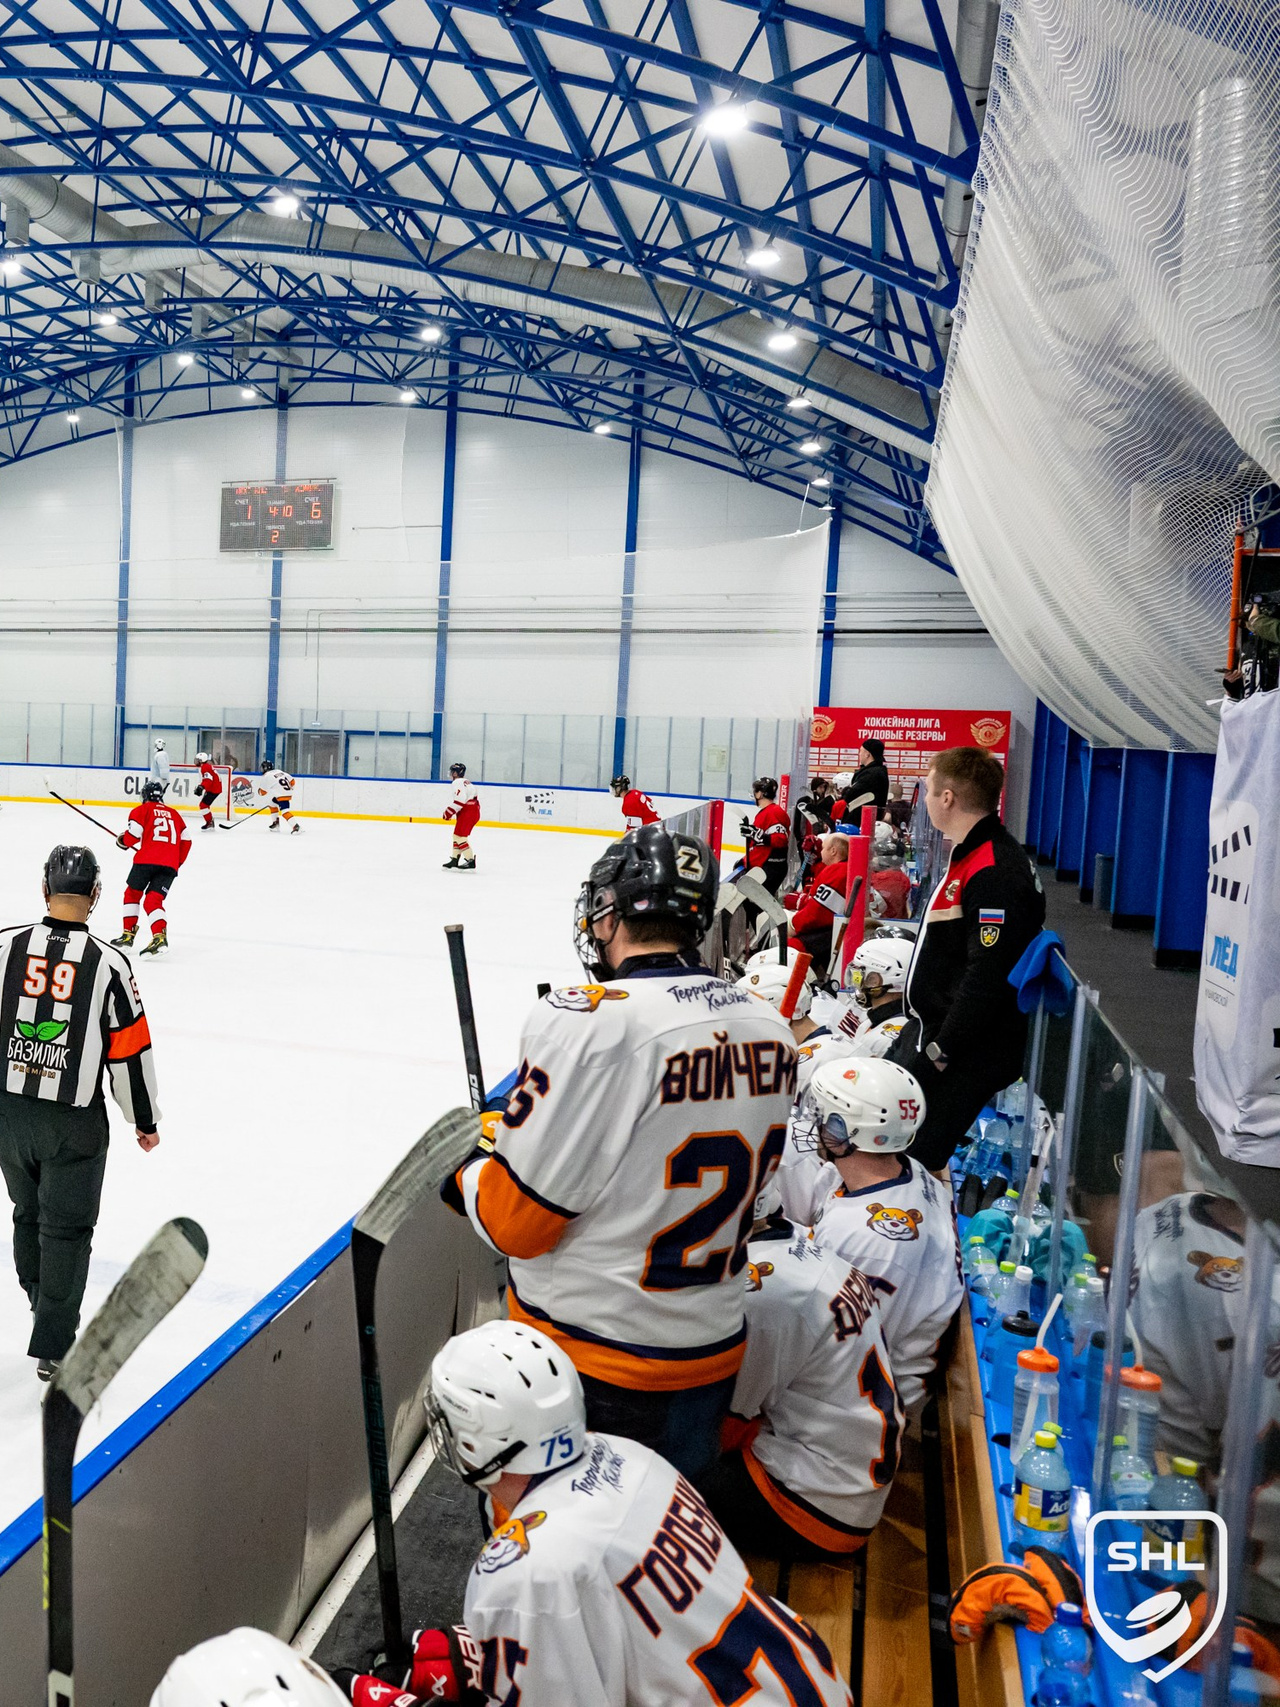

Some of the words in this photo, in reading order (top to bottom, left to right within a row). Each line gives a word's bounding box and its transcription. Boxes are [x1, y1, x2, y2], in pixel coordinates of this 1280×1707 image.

[247, 505, 252, 520] 1
[269, 505, 293, 517] 4:10
[311, 502, 321, 519] 6
[271, 530, 280, 543] 2
[864, 716, 916, 728] ХОККЕЙНАЯ
[916, 718, 941, 729] ЛИГА
[857, 729, 904, 740] ТРУДОВЫЕ
[905, 730, 946, 741] РЕЗЕРВЫ
[172, 777, 190, 798] 41
[152, 817, 178, 845] 21
[817, 883, 831, 901] 20
[46, 934, 70, 943] LUTCH
[1210, 935, 1239, 982] ЛЁД
[23, 956, 76, 1001] 59
[7, 1036, 71, 1070] БАЗИЛИК
[12, 1064, 57, 1080] PREMIUM
[661, 1030, 798, 1106] ВОЙЧЕН
[899, 1099, 919, 1120] 55
[540, 1433, 574, 1468] 75
